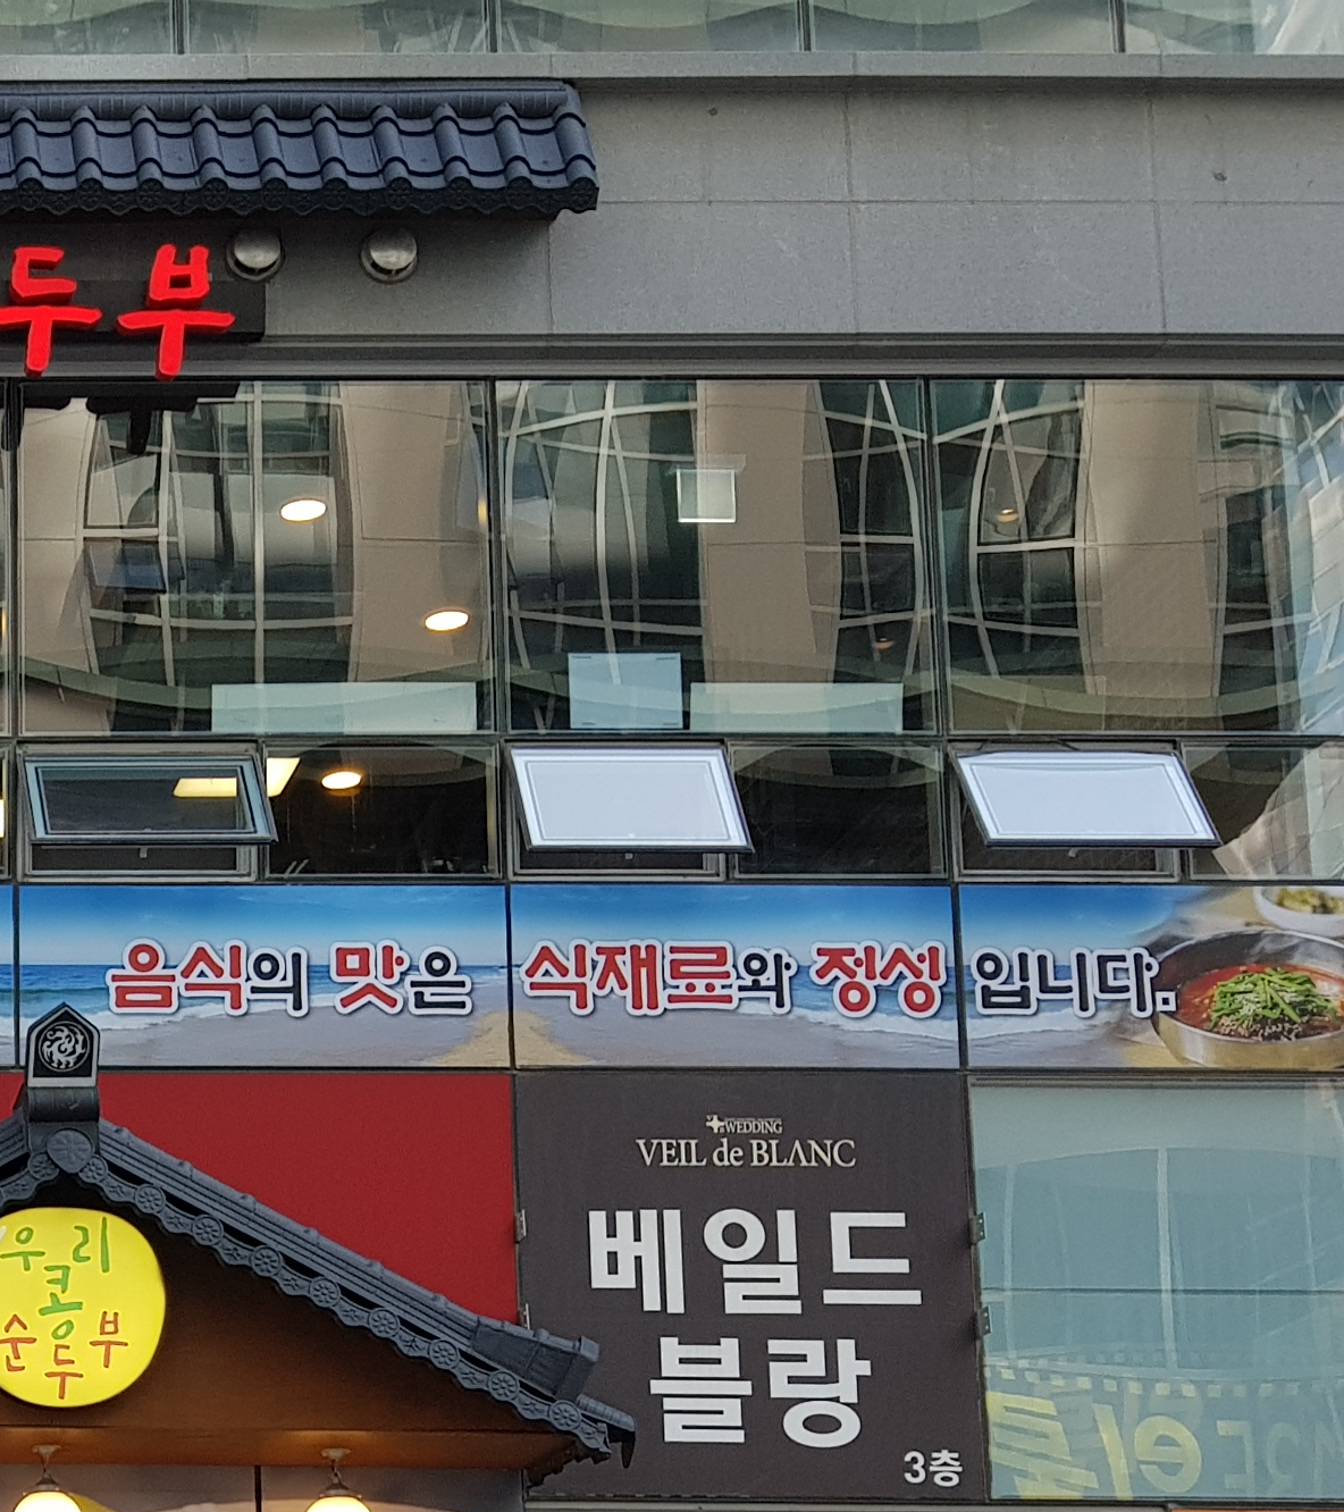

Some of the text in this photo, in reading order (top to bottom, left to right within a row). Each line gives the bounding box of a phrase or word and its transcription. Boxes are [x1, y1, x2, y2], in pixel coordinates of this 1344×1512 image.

[109, 940, 305, 1014] 음식의
[333, 942, 471, 1012] 맛은
[521, 940, 795, 1014] 식재료와
[636, 1138, 857, 1168] VEIL de BLANC
[725, 1119, 783, 1134] WEDDING
[588, 1208, 923, 1315] 베일드
[649, 1336, 873, 1449] 블랑
[903, 1449, 964, 1488] 3층
